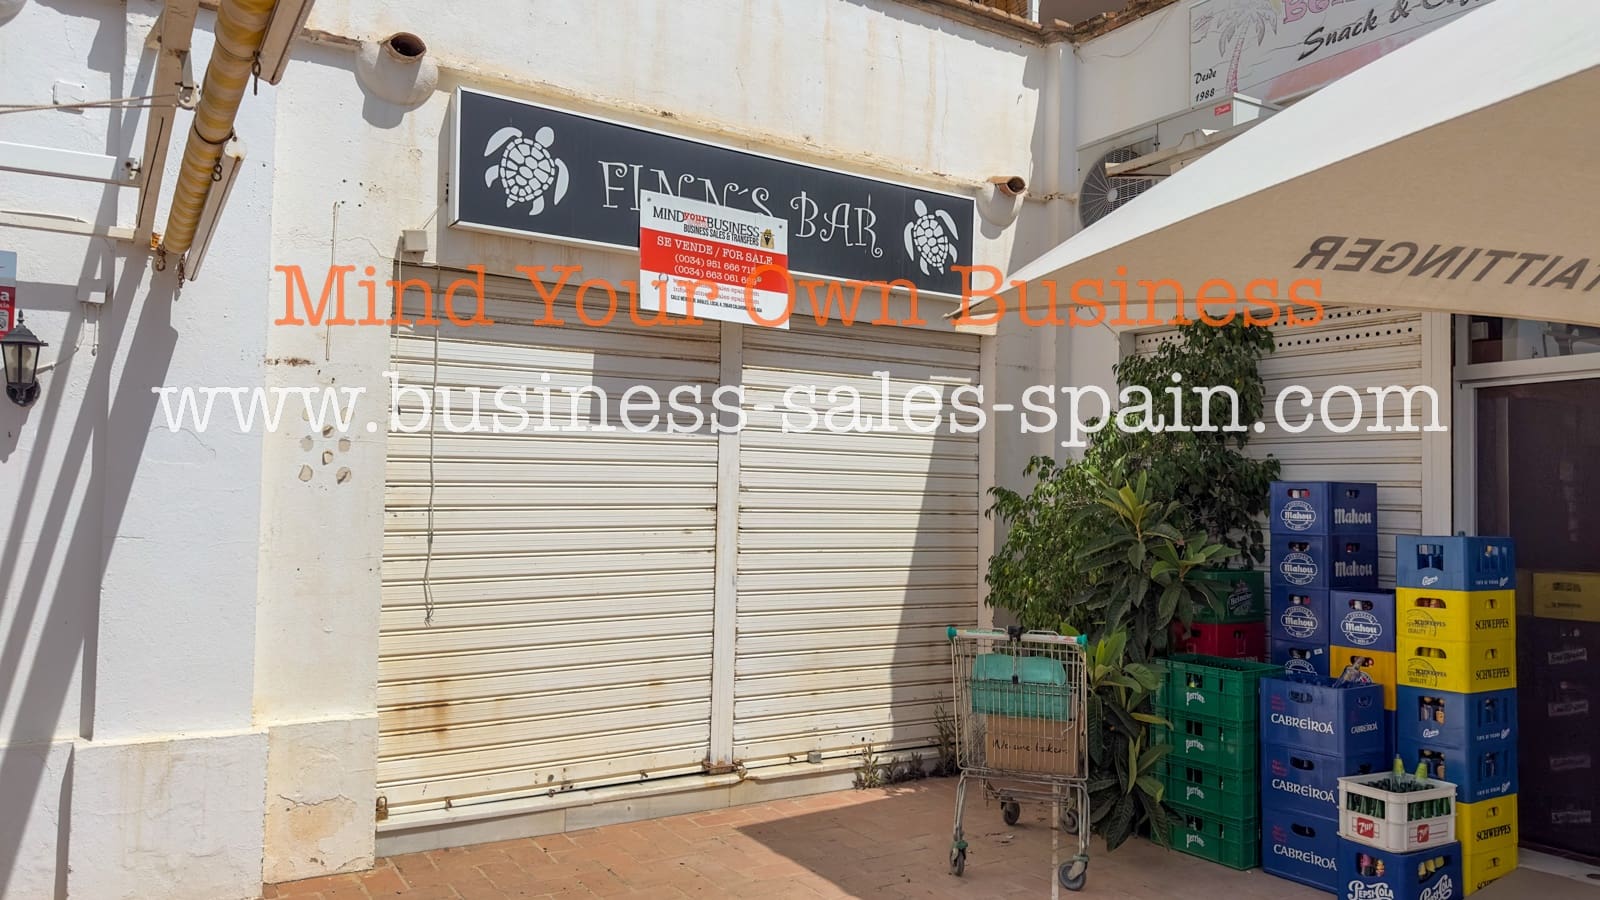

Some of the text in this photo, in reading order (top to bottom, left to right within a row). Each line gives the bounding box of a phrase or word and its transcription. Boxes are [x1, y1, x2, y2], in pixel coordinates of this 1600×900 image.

[1298, 8, 1378, 61] Snack
[1194, 68, 1217, 85] Desde
[1195, 88, 1215, 102] 1988
[790, 191, 883, 258] BAR
[683, 224, 709, 237] BUSINESS
[710, 229, 726, 240] SALES
[731, 233, 760, 246] TRANSFERS
[657, 236, 672, 247] SE
[674, 239, 713, 255] VENDE
[722, 248, 743, 261] FOR
[745, 253, 773, 265] SALE
[674, 254, 705, 267] (0034)
[706, 259, 721, 269] 951
[674, 266, 704, 278] (0034)
[706, 270, 723, 280] 663
[724, 272, 739, 282] 061
[1284, 510, 1312, 520] Mahou
[1334, 508, 1372, 524] Mahou
[1284, 563, 1314, 574] Mahou
[1335, 560, 1373, 578] Mahou
[1285, 617, 1314, 628] Mahou
[1345, 622, 1377, 634] Mahou
[1475, 618, 1509, 631] SCHWEPPES
[1475, 667, 1510, 681] SCHWEPPES
[1476, 823, 1511, 842] SCHWEPPES
